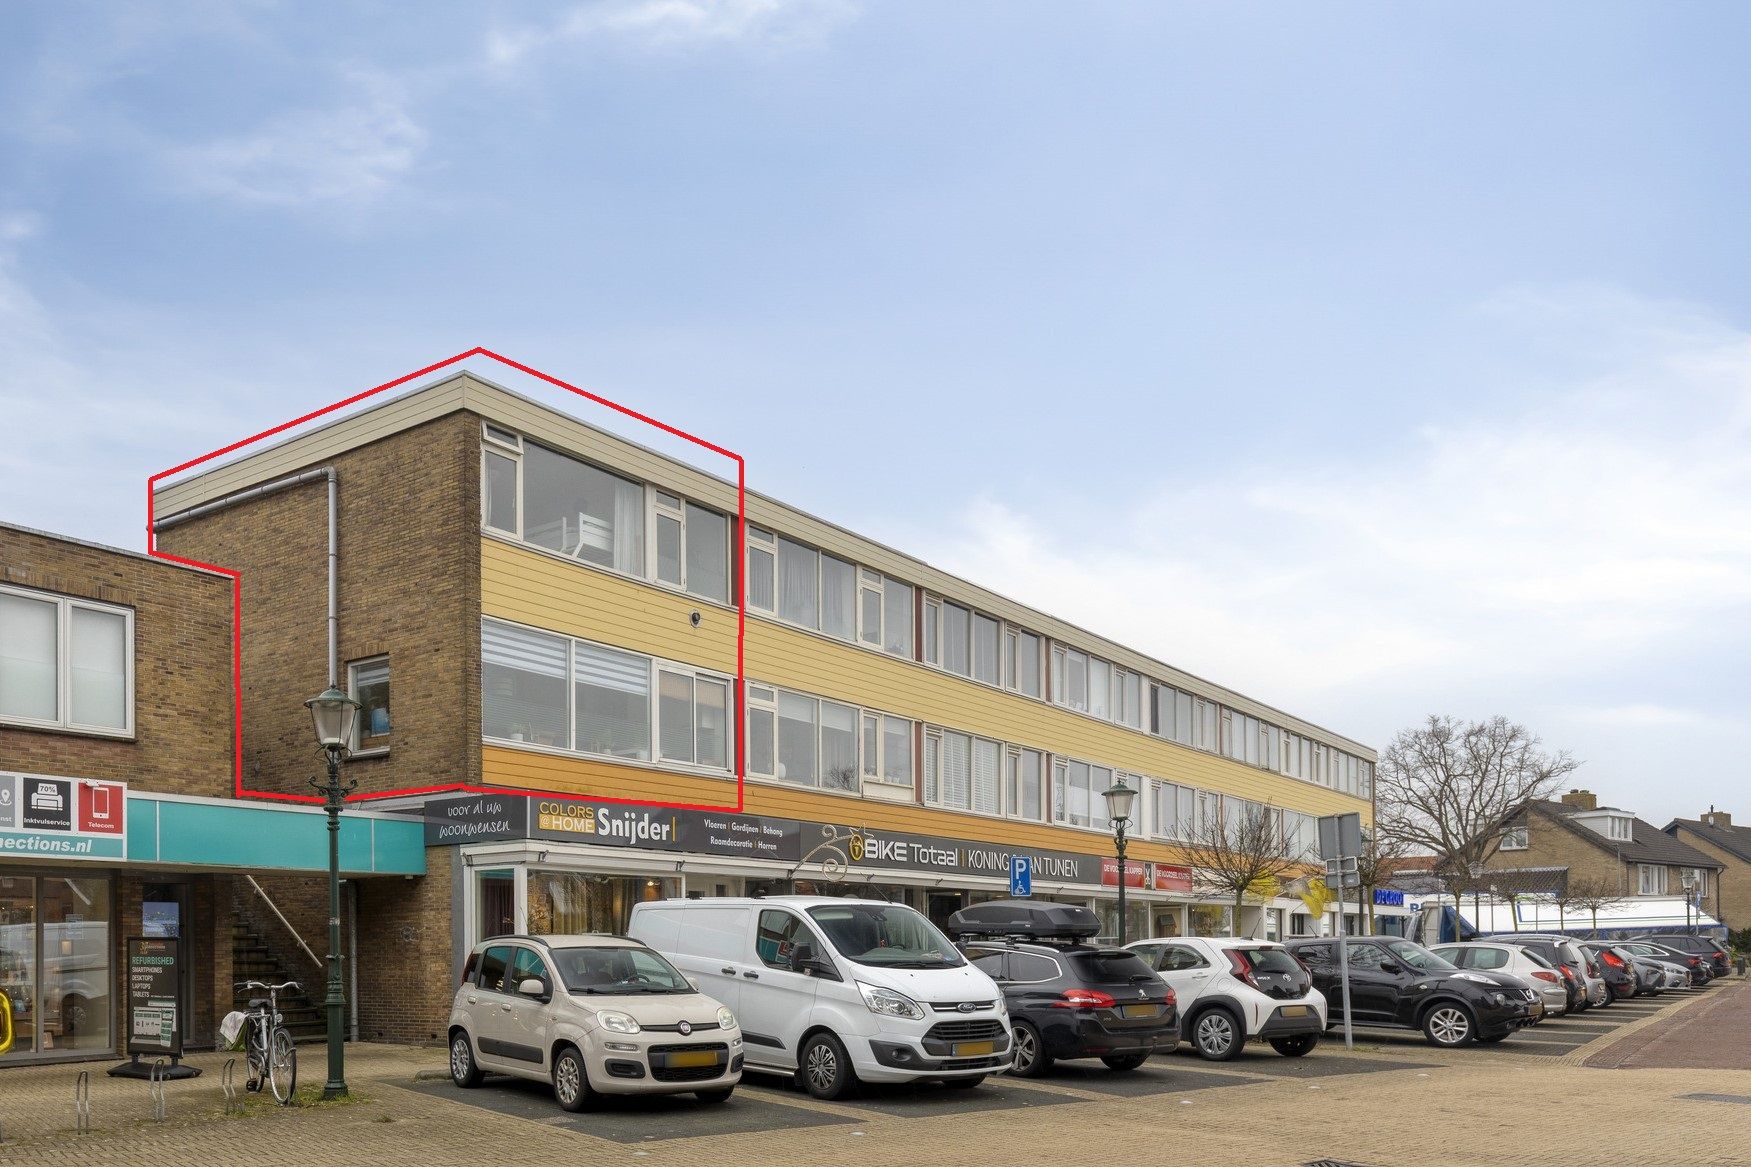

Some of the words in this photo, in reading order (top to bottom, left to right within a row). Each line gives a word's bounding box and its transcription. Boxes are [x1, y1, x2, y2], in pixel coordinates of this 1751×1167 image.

[40, 785, 56, 793] 70%
[447, 805, 470, 817] voor
[473, 800, 483, 814] al
[486, 802, 502, 814] uw
[540, 802, 594, 819] COLORS
[23, 817, 71, 826] Inktvulservice
[88, 821, 115, 829] Telecom
[440, 820, 510, 839] woonwensen
[552, 817, 595, 833] HOME
[597, 807, 670, 845] Snijder
[704, 819, 727, 830] Vloeren
[731, 822, 759, 834] Gordijnen
[0, 836, 93, 853] ections.nl
[710, 836, 753, 849] Raamdecoratie
[865, 839, 908, 862] BIKE
[909, 844, 959, 867] Totaal
[968, 849, 1010, 872] KONING
[1043, 857, 1079, 878] TUNEN
[1015, 859, 1027, 880] P
[131, 956, 174, 965] REFURBISHED
[131, 974, 153, 982] DESKTOPS
